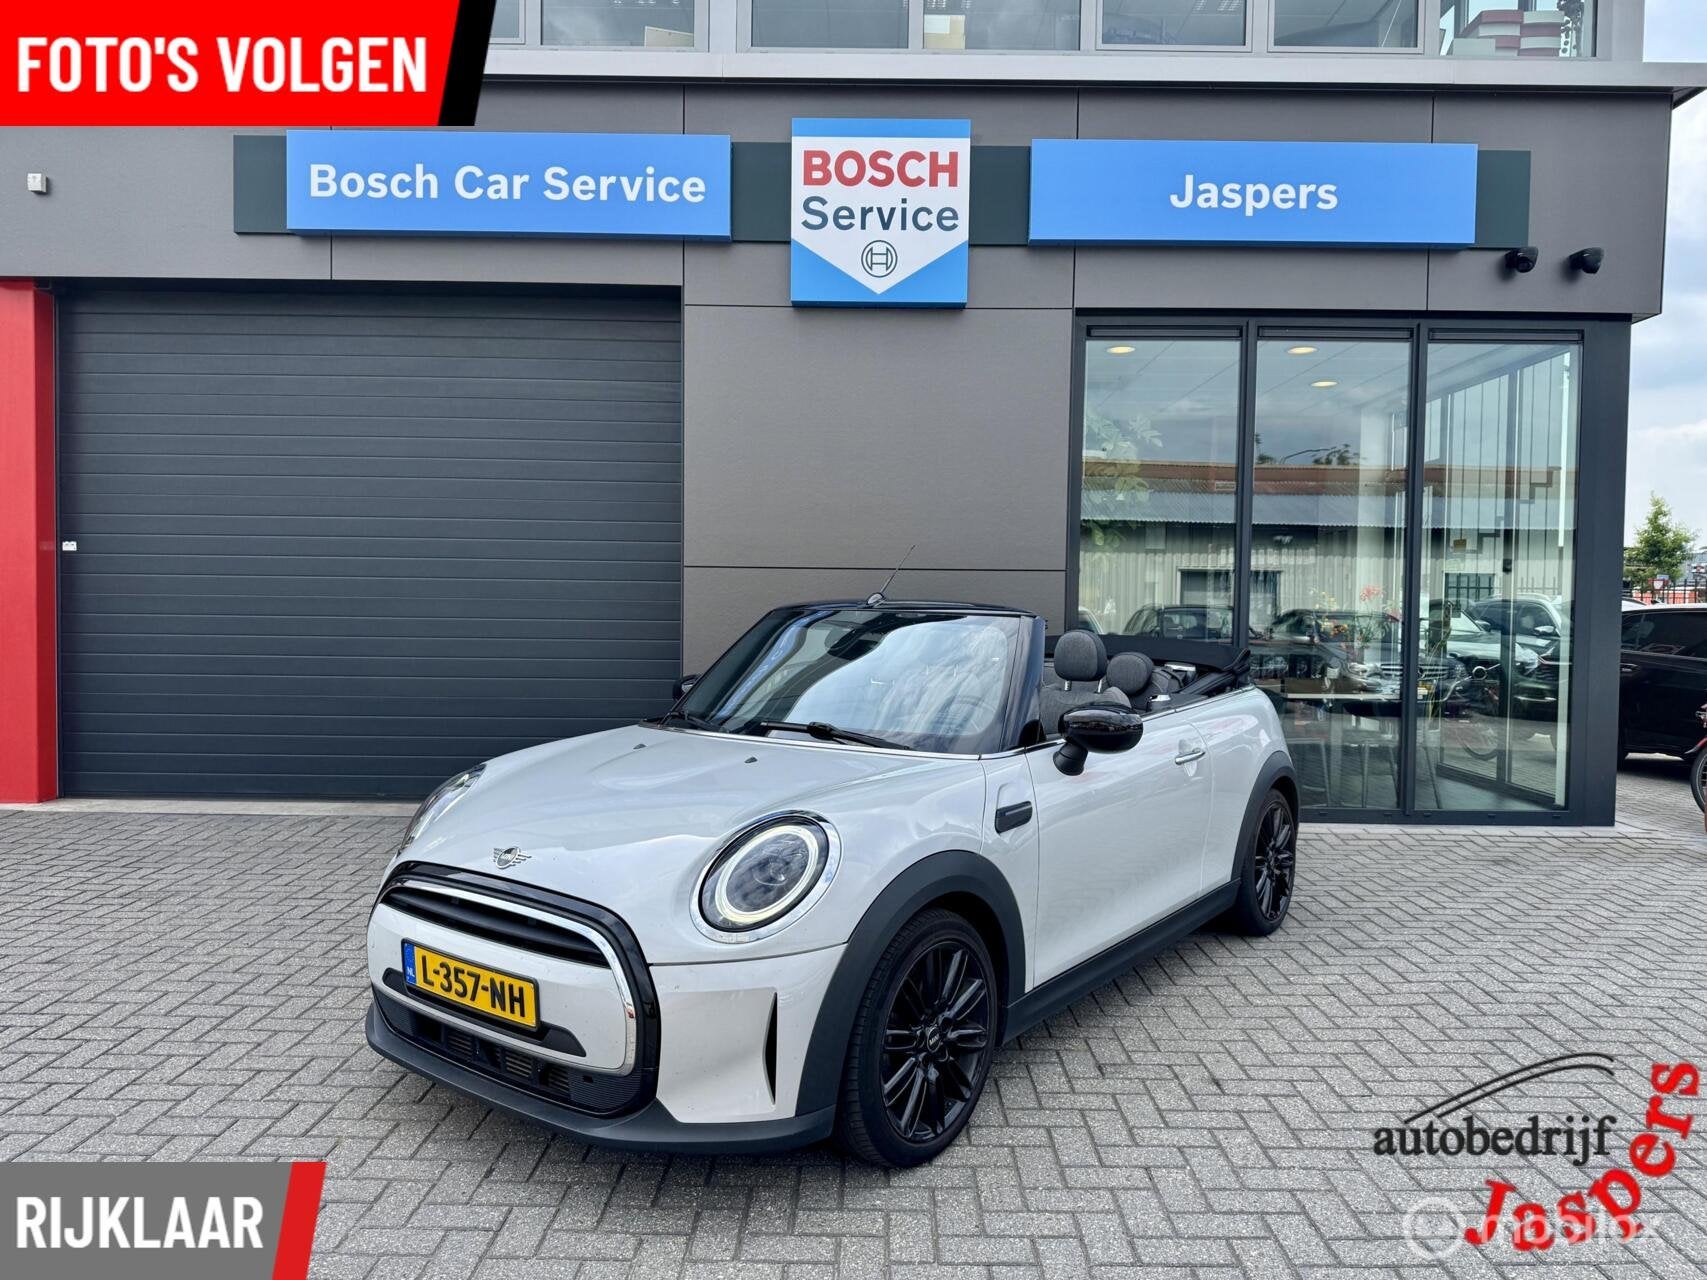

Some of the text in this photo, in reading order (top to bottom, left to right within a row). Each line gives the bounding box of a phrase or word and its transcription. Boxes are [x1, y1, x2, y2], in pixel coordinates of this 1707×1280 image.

[310, 163, 706, 203] Bosch Car Service
[803, 150, 959, 188] BOSCH
[801, 195, 959, 232] Service
[1169, 174, 1338, 217] Jaspers
[421, 954, 526, 1018] L-357-NH
